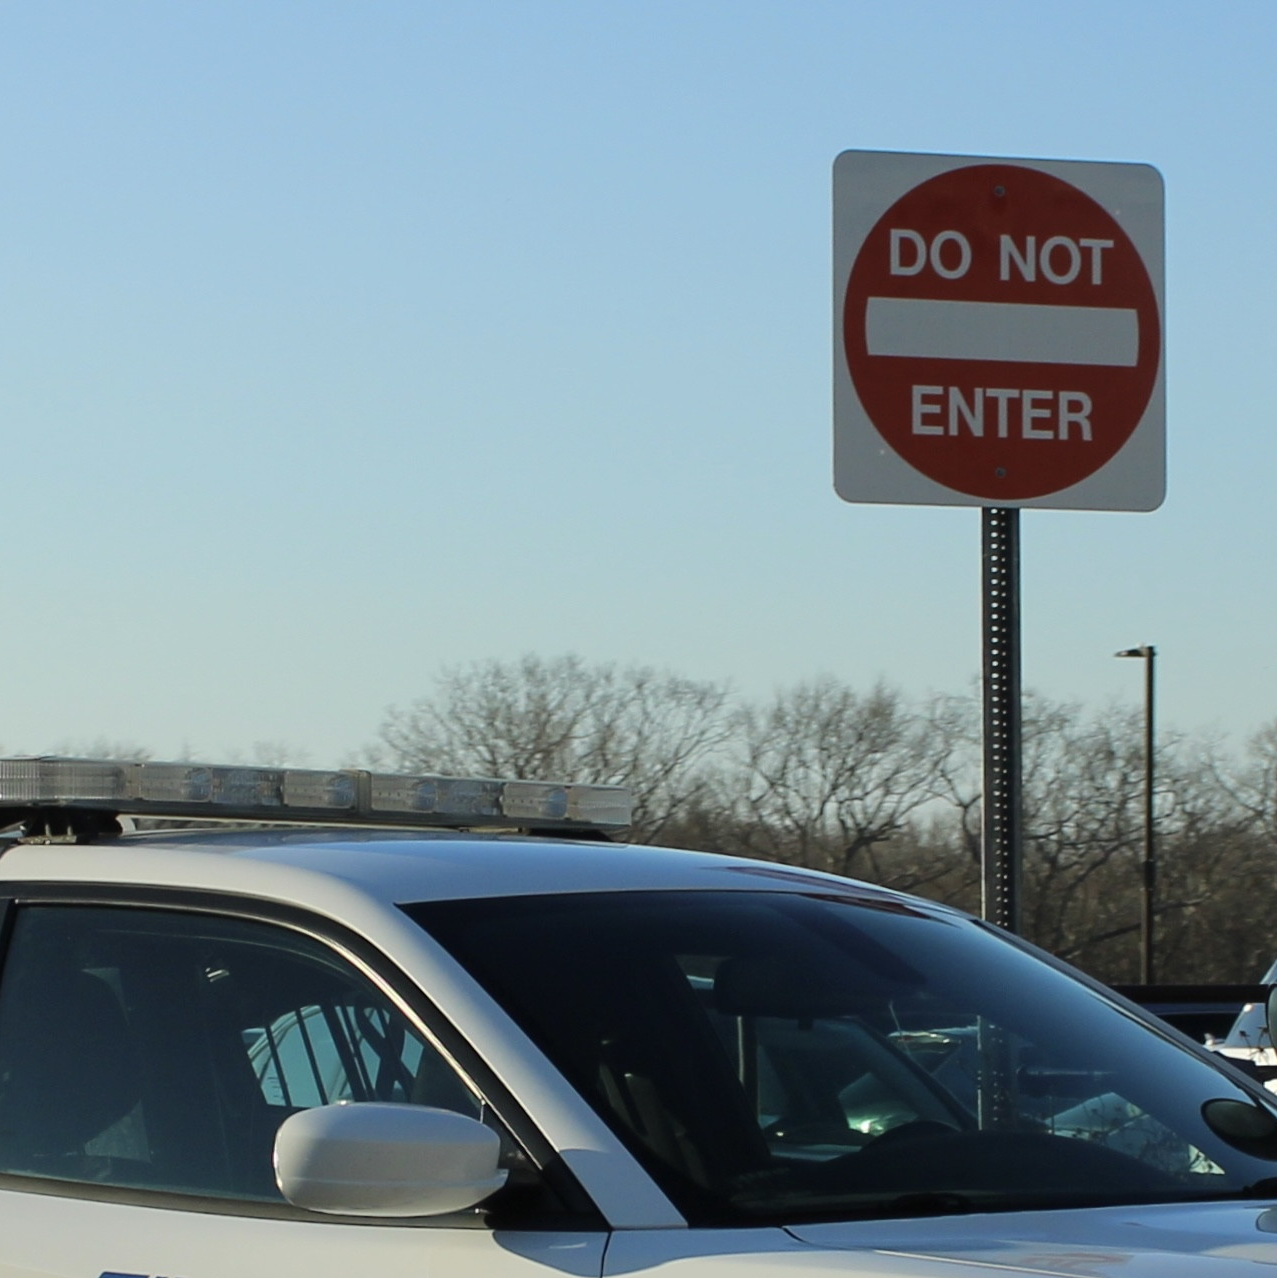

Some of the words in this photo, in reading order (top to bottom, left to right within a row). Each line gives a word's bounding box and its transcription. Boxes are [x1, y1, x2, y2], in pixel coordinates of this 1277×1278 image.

[889, 228, 972, 280] DO
[999, 233, 1115, 285] NOT
[910, 384, 1094, 441] ENTER
